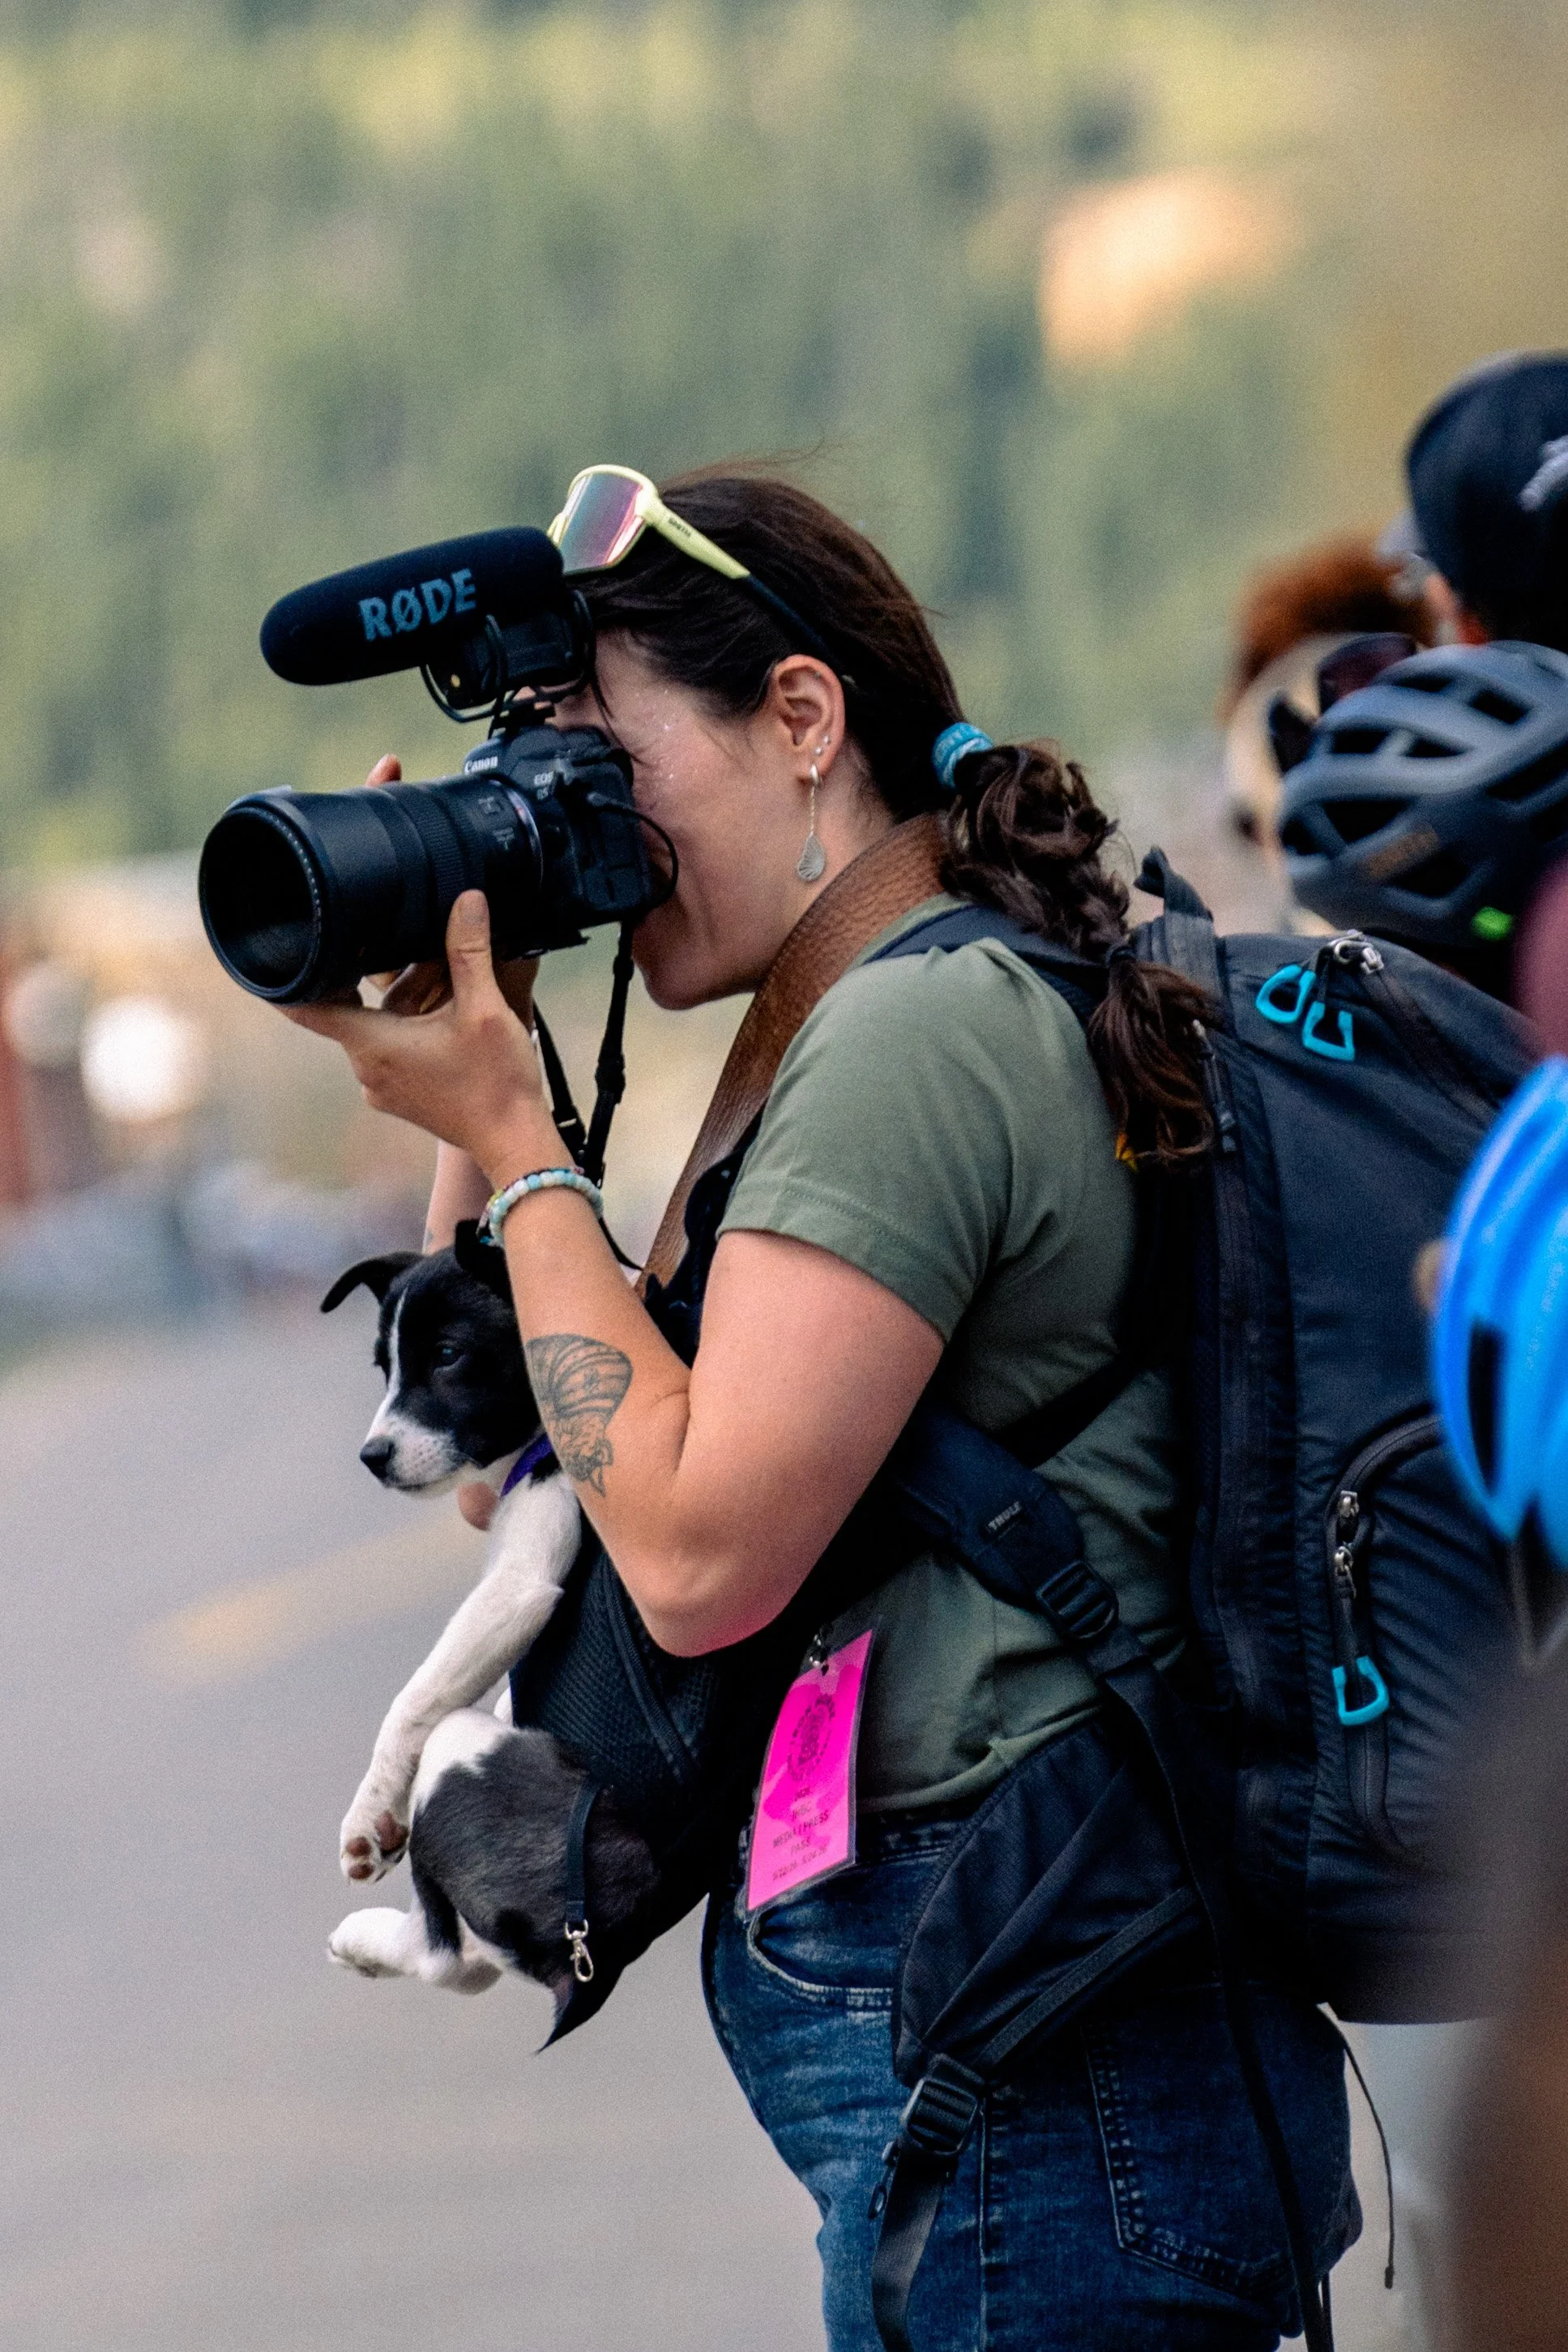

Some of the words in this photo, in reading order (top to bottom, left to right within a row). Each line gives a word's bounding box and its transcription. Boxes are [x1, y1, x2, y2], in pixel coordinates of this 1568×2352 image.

[358, 568, 476, 641] RØDE
[464, 755, 498, 775] Canon
[533, 771, 554, 786] EOS
[802, 1809, 829, 1832] PRESS
[791, 1836, 811, 1855] PASS
